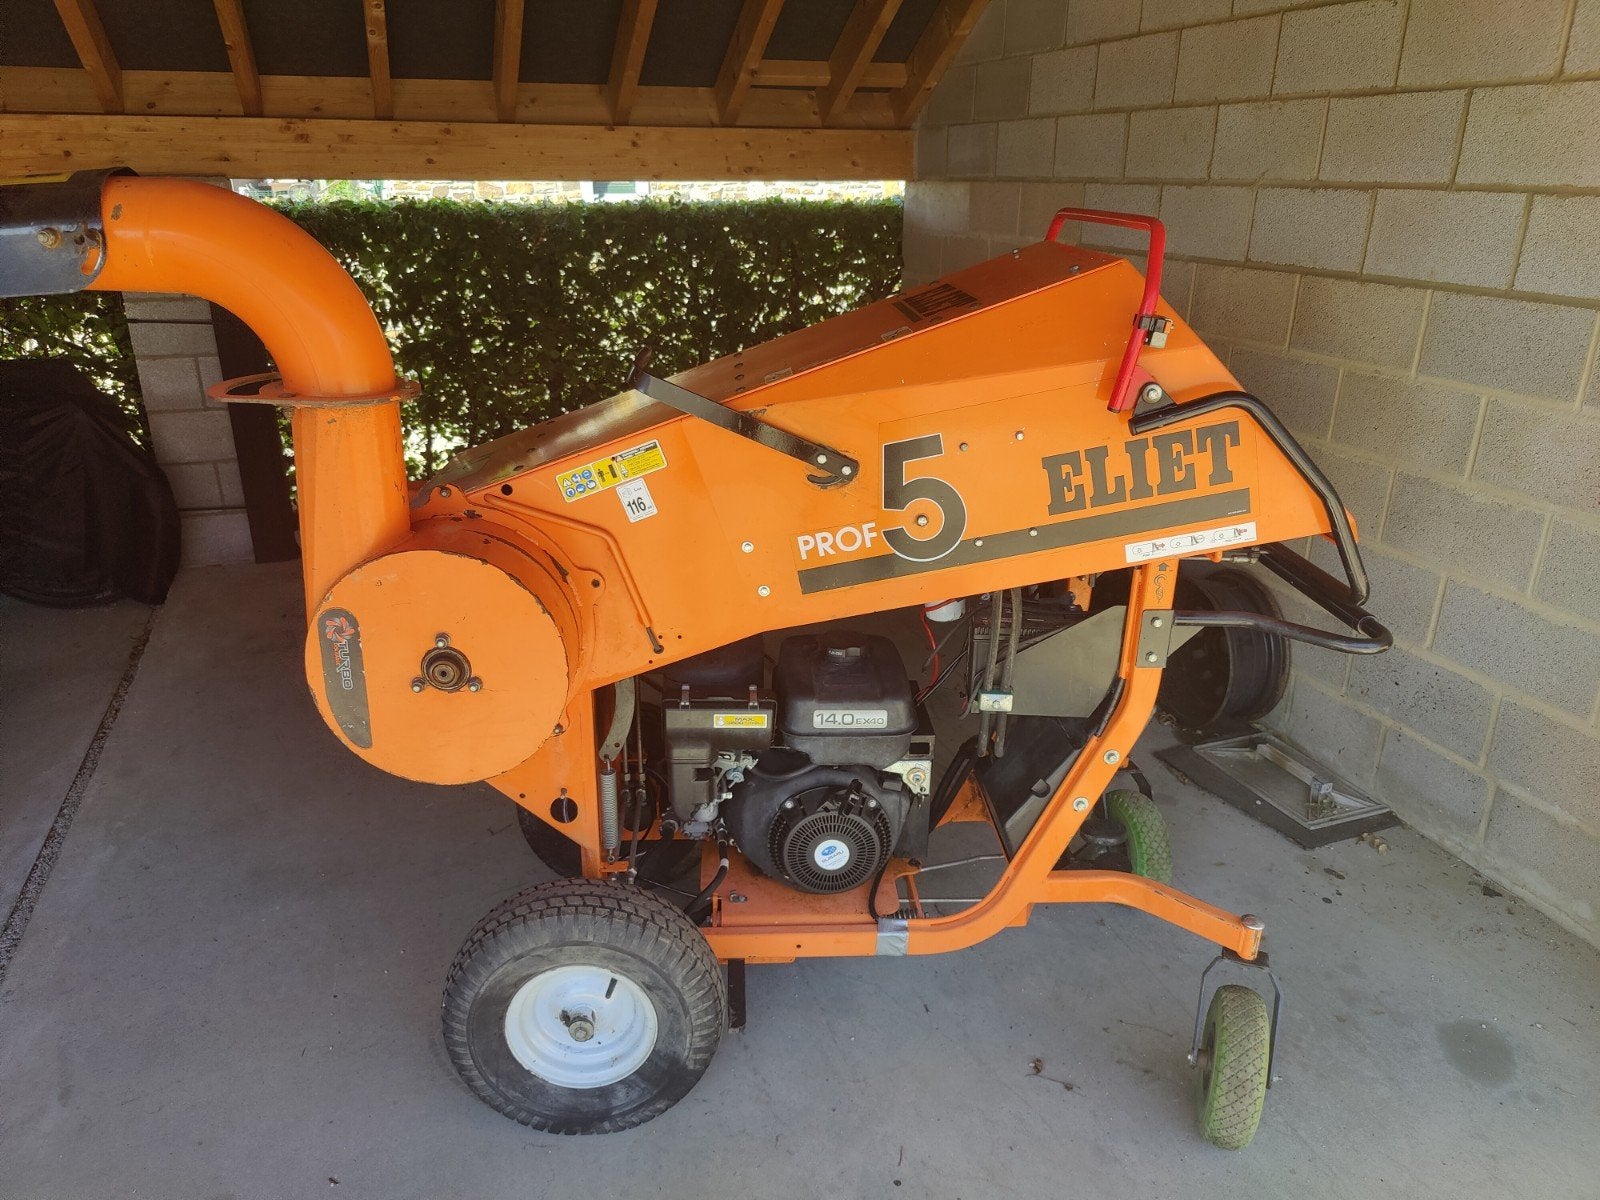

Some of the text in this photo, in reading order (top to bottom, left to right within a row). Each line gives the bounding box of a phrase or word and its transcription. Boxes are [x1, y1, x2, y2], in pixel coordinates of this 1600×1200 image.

[797, 433, 967, 562] PROF 5
[1042, 420, 1240, 516] ELIET
[627, 497, 646, 515] 116
[335, 639, 353, 690] TURBO
